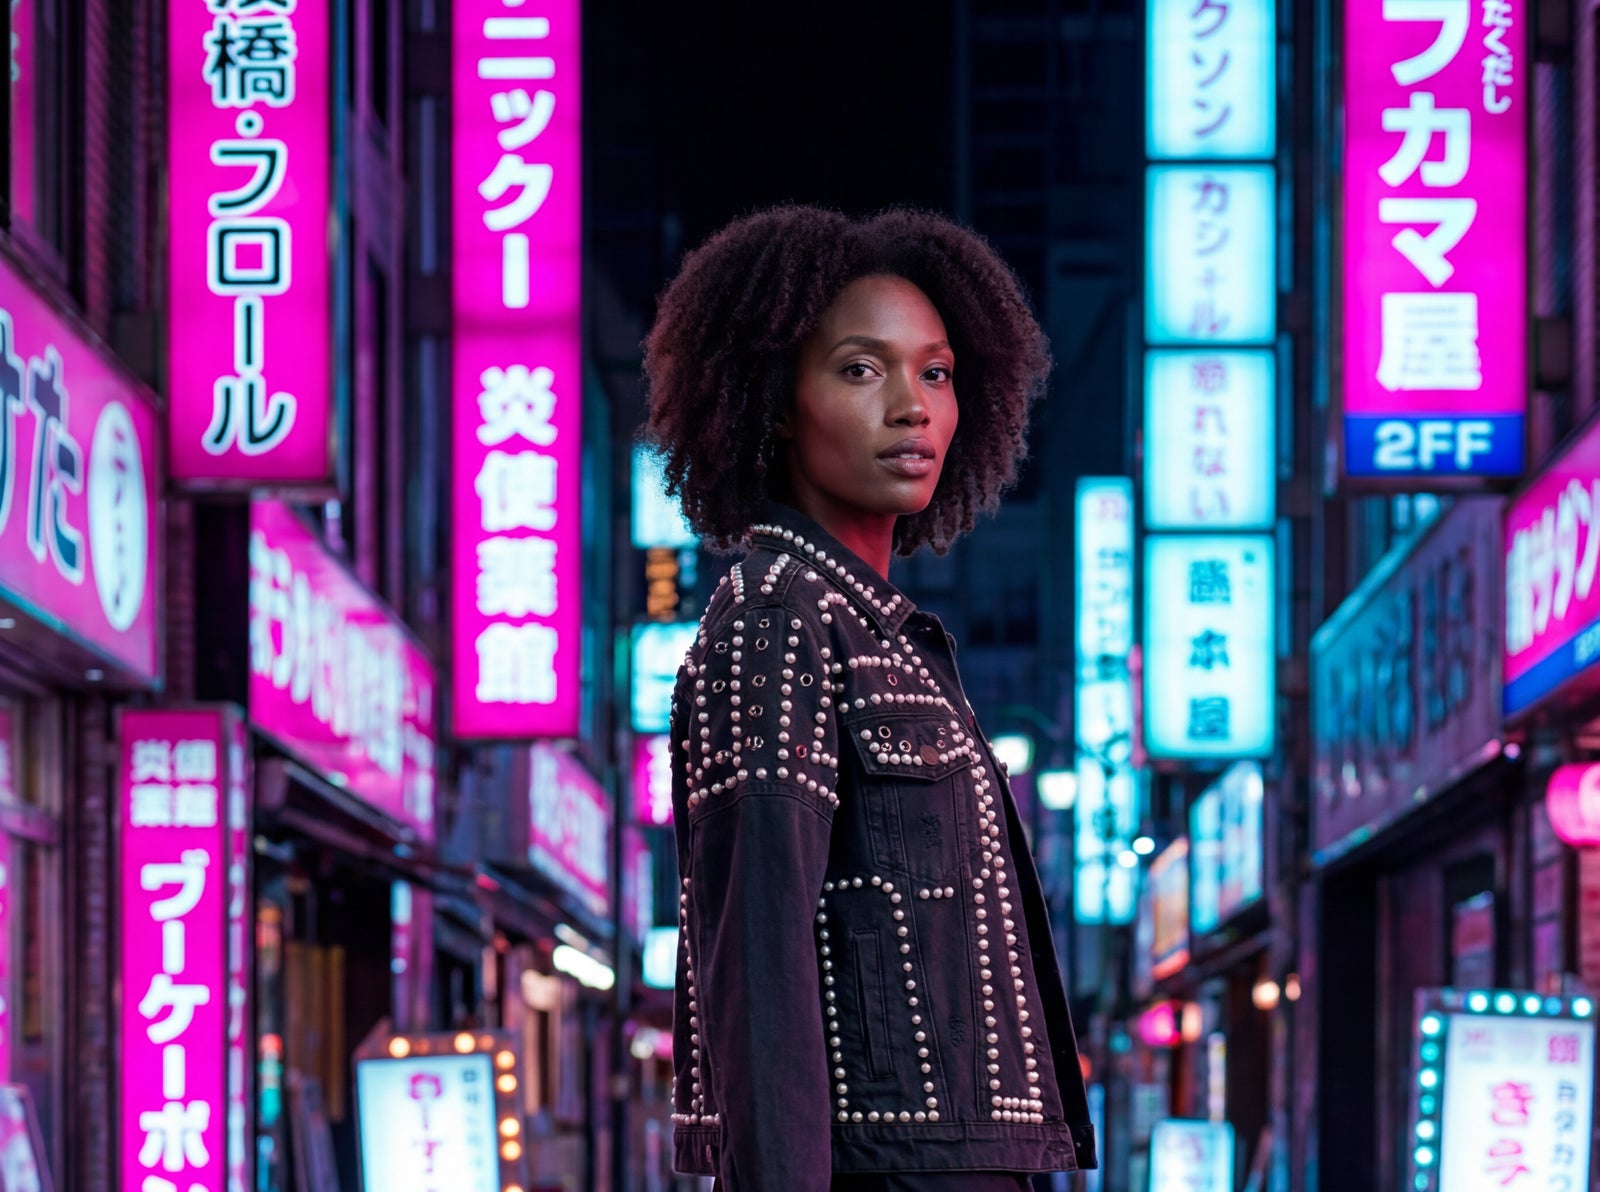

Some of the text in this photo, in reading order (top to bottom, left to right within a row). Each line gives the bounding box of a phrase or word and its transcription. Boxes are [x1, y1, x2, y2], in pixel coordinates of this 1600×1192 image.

[202, 0, 296, 457] 橋・フロール
[477, 0, 556, 309] ニックー
[1373, 420, 1494, 471] 2FF
